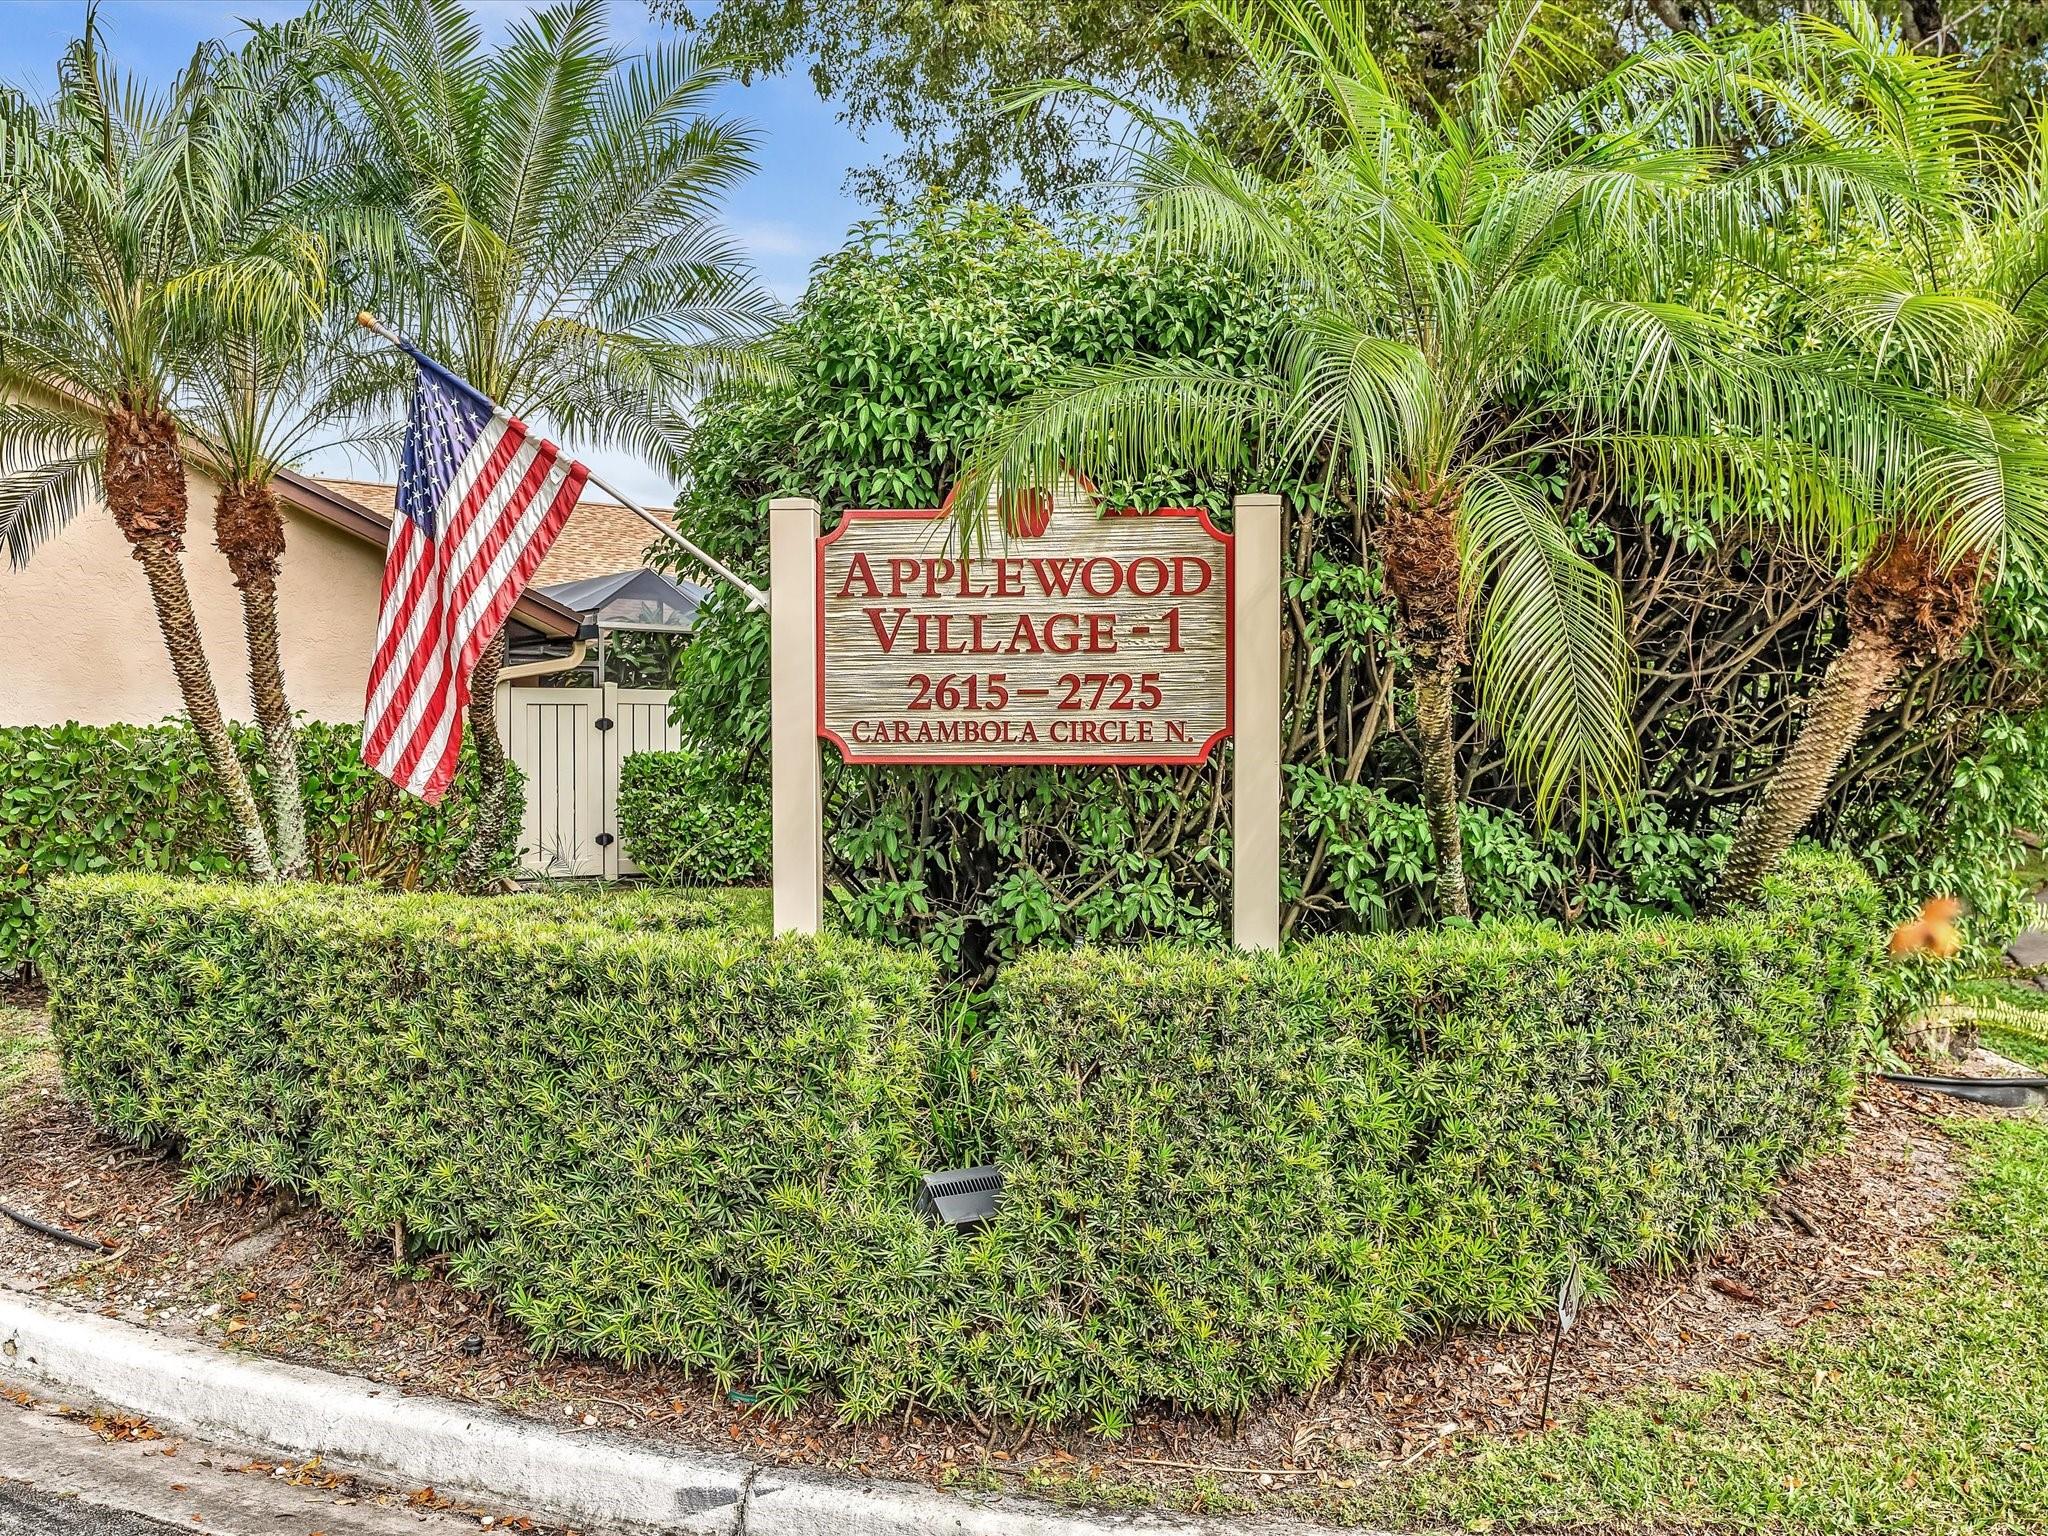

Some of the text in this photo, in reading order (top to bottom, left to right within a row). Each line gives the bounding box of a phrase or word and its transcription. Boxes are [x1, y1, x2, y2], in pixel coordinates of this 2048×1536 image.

[836, 552, 1213, 598] APPLEWOOD
[851, 720, 1195, 743] CARAMBOLA CIRCLE N.
